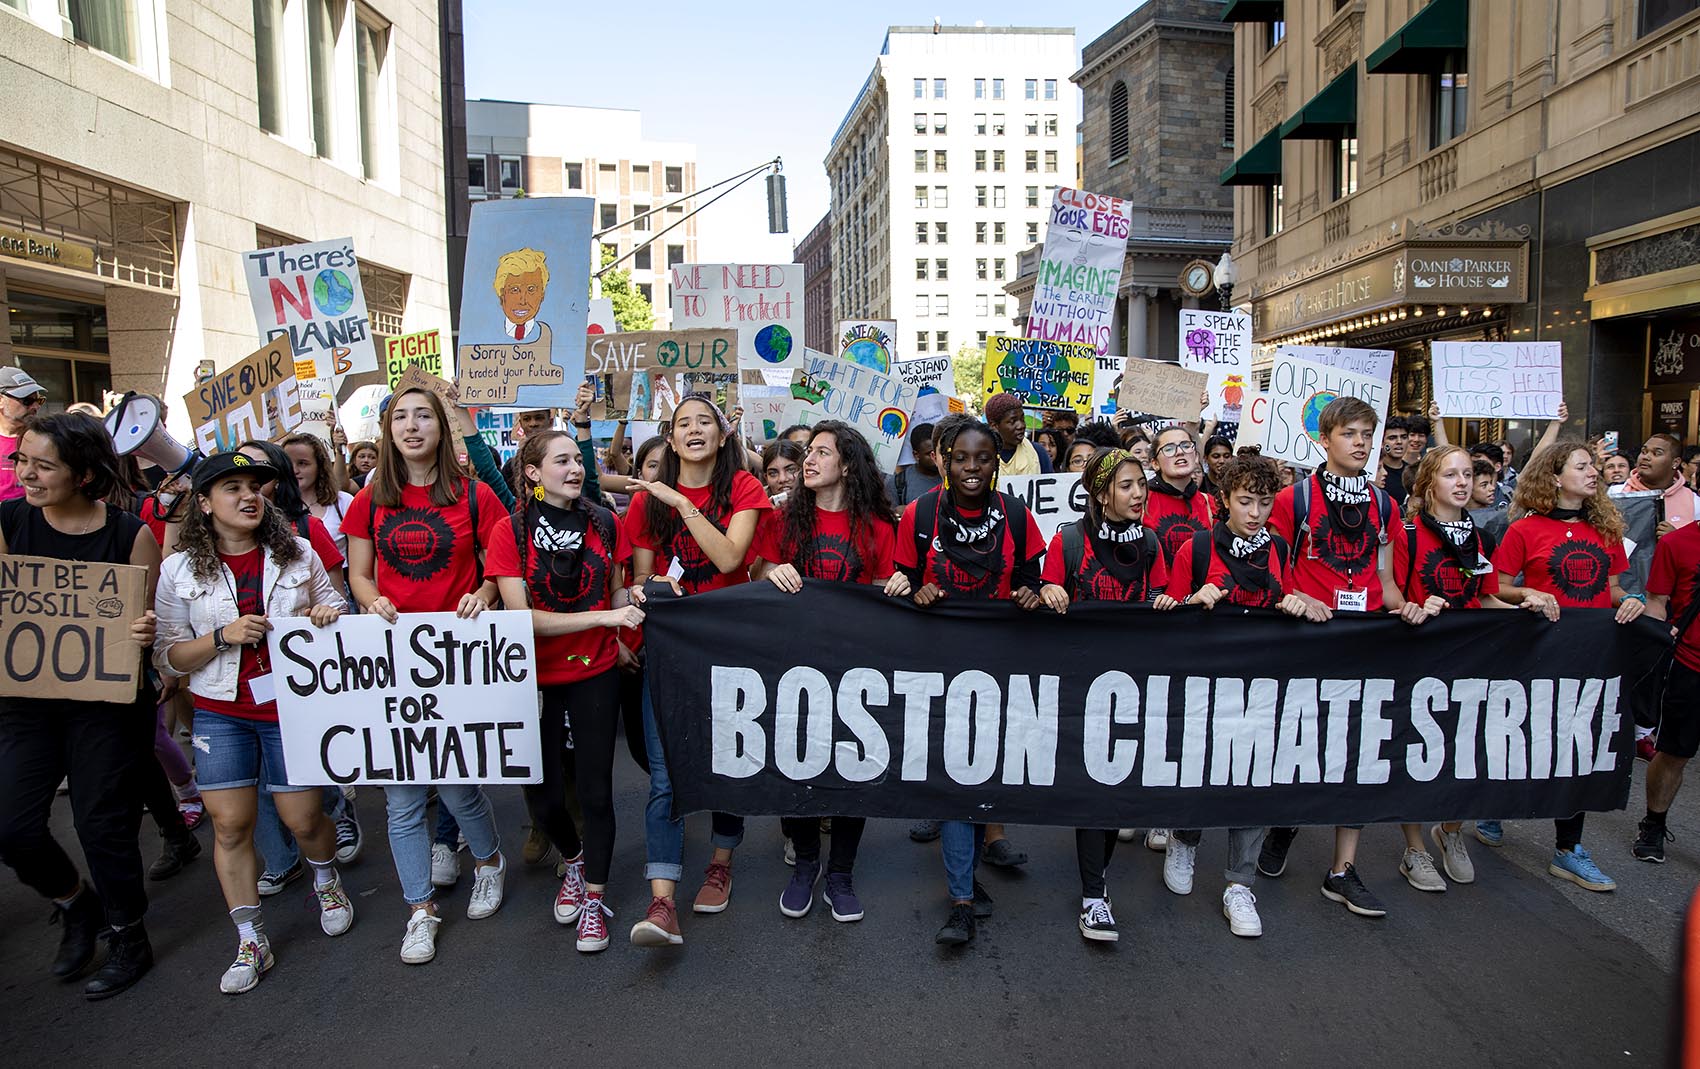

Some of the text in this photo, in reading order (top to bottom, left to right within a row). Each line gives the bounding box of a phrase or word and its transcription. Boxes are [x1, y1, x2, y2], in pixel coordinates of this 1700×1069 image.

[1058, 187, 1123, 216] CLOSE
[1053, 204, 1130, 239] YOUR EYES
[27, 238, 60, 258] Bank
[249, 245, 356, 277] There's
[1411, 259, 1511, 273] OMNI PARKER
[672, 264, 785, 290] WE NEED
[1039, 259, 1120, 298] IMAGINE
[1439, 274, 1484, 288] HOUSE
[269, 269, 354, 325] NO
[1068, 290, 1105, 306] EARTH
[1336, 275, 1371, 308] HOUSE
[676, 294, 706, 317] TO
[1034, 300, 1107, 322] WITHOUT
[1185, 313, 1245, 331] I SPEAK
[389, 331, 439, 360] FIGHT
[1026, 316, 1111, 356] HUMANS
[1186, 329, 1241, 347] FOR THE
[471, 344, 536, 366] Sorry Son,
[585, 337, 730, 374] SAVE OUR
[996, 338, 1035, 354] SORRY
[1058, 344, 1096, 359] JACKSON
[1189, 346, 1240, 366] TREES
[897, 358, 949, 376] WE STAND
[1023, 353, 1051, 369] (OH)
[1097, 357, 1120, 370] THE
[469, 366, 499, 379] traded
[503, 367, 524, 384] your
[528, 363, 561, 378] future
[919, 373, 942, 383] WHAT
[997, 364, 1089, 387] CLIMATE CHANGE
[1275, 361, 1319, 400] OUR
[1512, 372, 1559, 392] HEAT
[200, 350, 283, 420] SAVE OUR
[466, 386, 507, 400] for oil!
[1030, 380, 1043, 392] IS
[1005, 388, 1074, 409] FOR REAL
[762, 419, 778, 440] B
[1266, 398, 1289, 454] IS
[1007, 478, 1059, 515] WE
[396, 530, 430, 544] CLIMATE
[398, 543, 427, 557] STRIKE
[1566, 558, 1594, 570] CLIMATE
[1568, 569, 1592, 581] STRIKE
[54, 564, 89, 590] BE
[98, 568, 119, 594] A
[0, 590, 90, 618] FOSSIL
[0, 620, 131, 683] OOL
[279, 623, 528, 697] School Strike
[385, 693, 444, 724] FOR
[711, 665, 1622, 788] BOSTON CLIMATE STRIKE
[320, 721, 531, 784] CLIMATE
